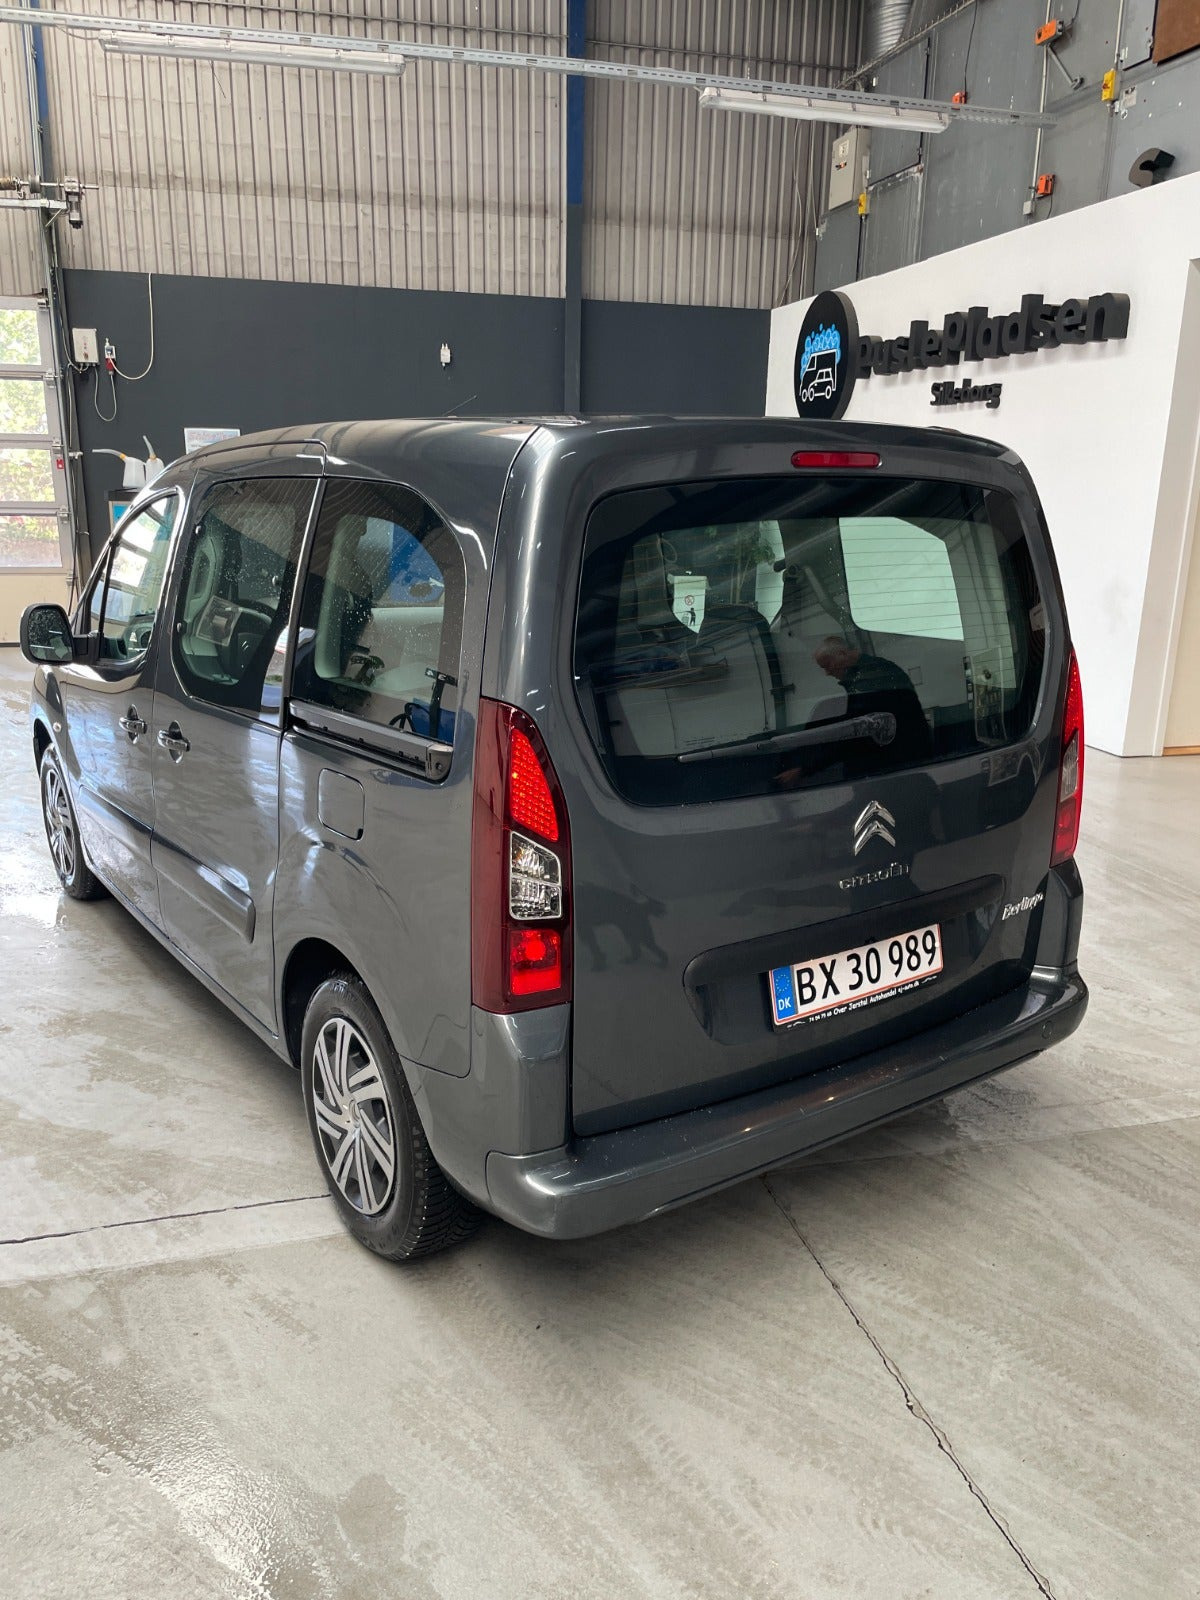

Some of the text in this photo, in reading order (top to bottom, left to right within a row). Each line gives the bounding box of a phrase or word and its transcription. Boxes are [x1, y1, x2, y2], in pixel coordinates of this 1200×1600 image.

[1001, 892, 1043, 920] Berlingo
[796, 930, 936, 1006] BX 30 989
[778, 996, 791, 1010] DK
[833, 1006, 848, 1015] Over
[869, 988, 897, 1003] Autohandel
